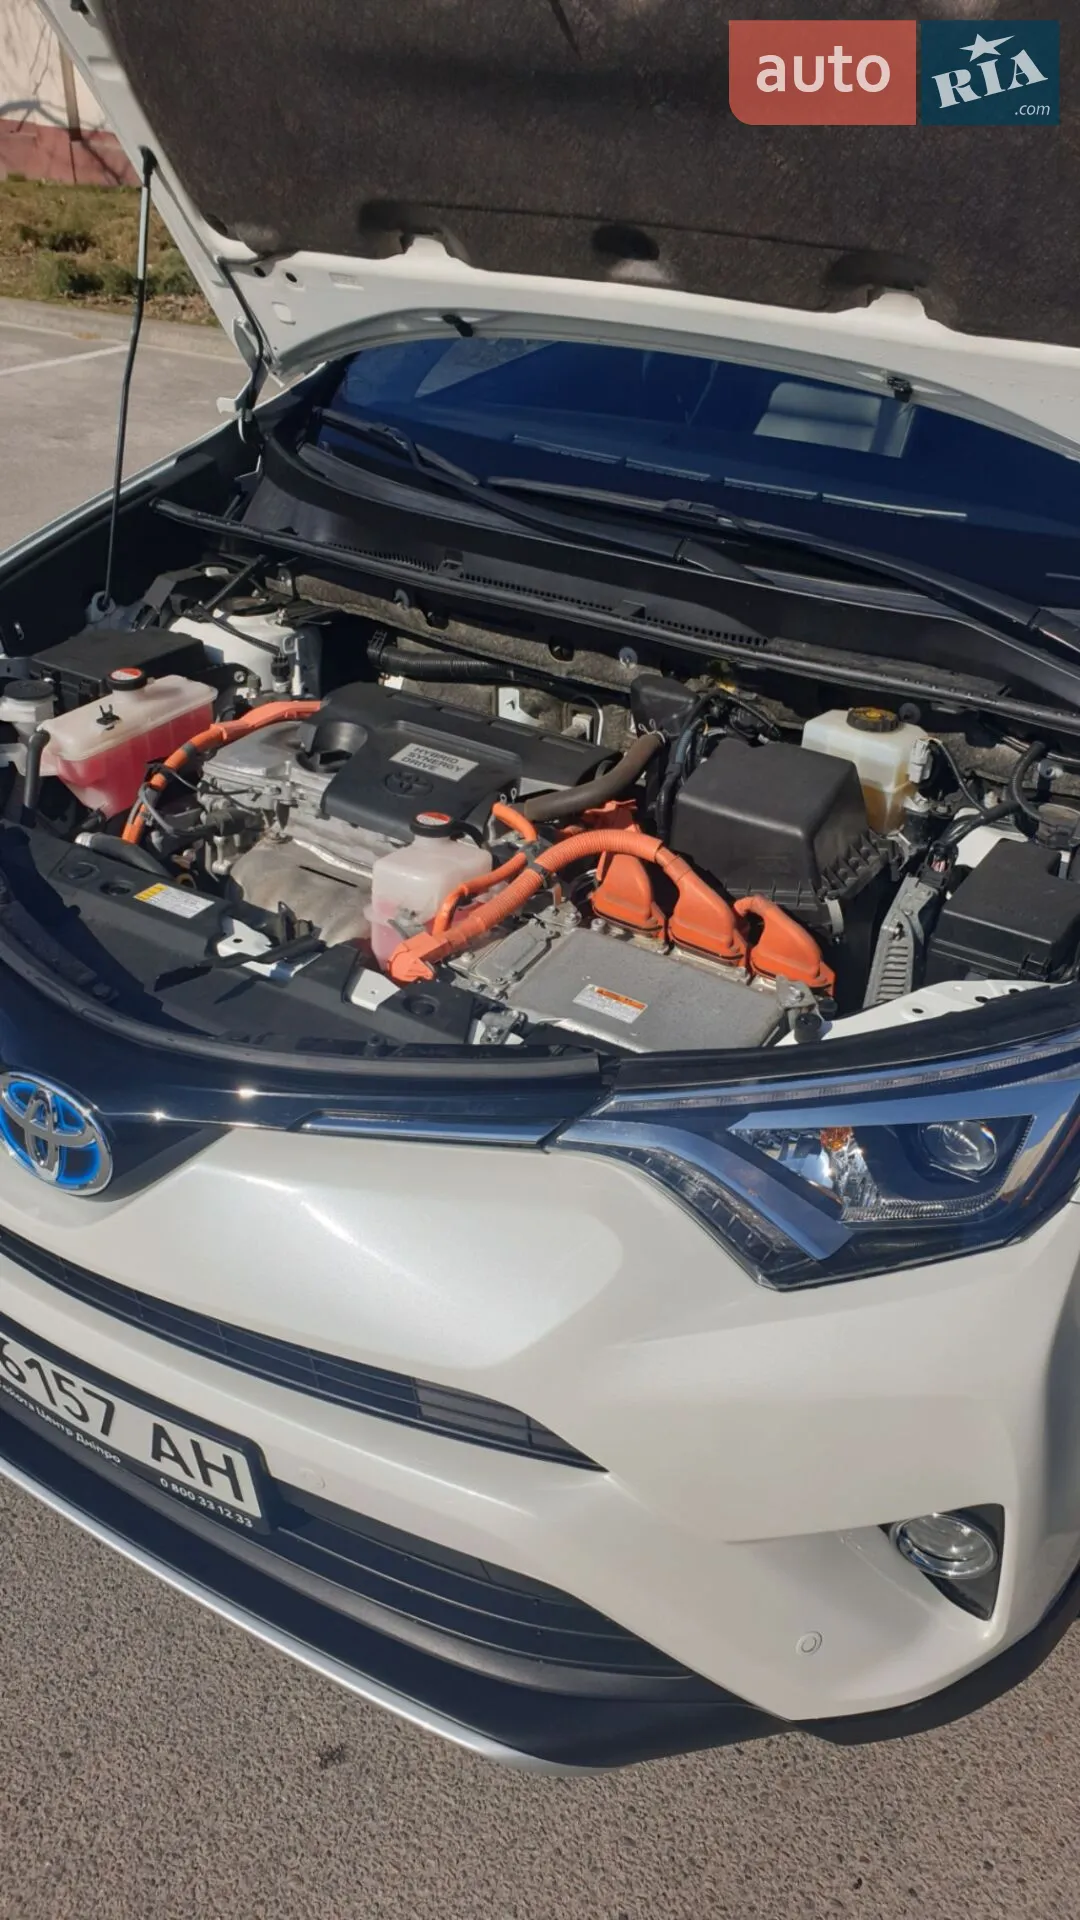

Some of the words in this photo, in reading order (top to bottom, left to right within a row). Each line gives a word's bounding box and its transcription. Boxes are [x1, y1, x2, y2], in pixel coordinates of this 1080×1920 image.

[401, 756, 437, 771] DRIVE
[407, 751, 464, 772] SYNERGY
[413, 747, 459, 764] HYBRID
[151, 1422, 245, 1502] AH
[160, 1477, 169, 1489] 0
[171, 1483, 196, 1501] 800
[217, 1505, 234, 1519] 12
